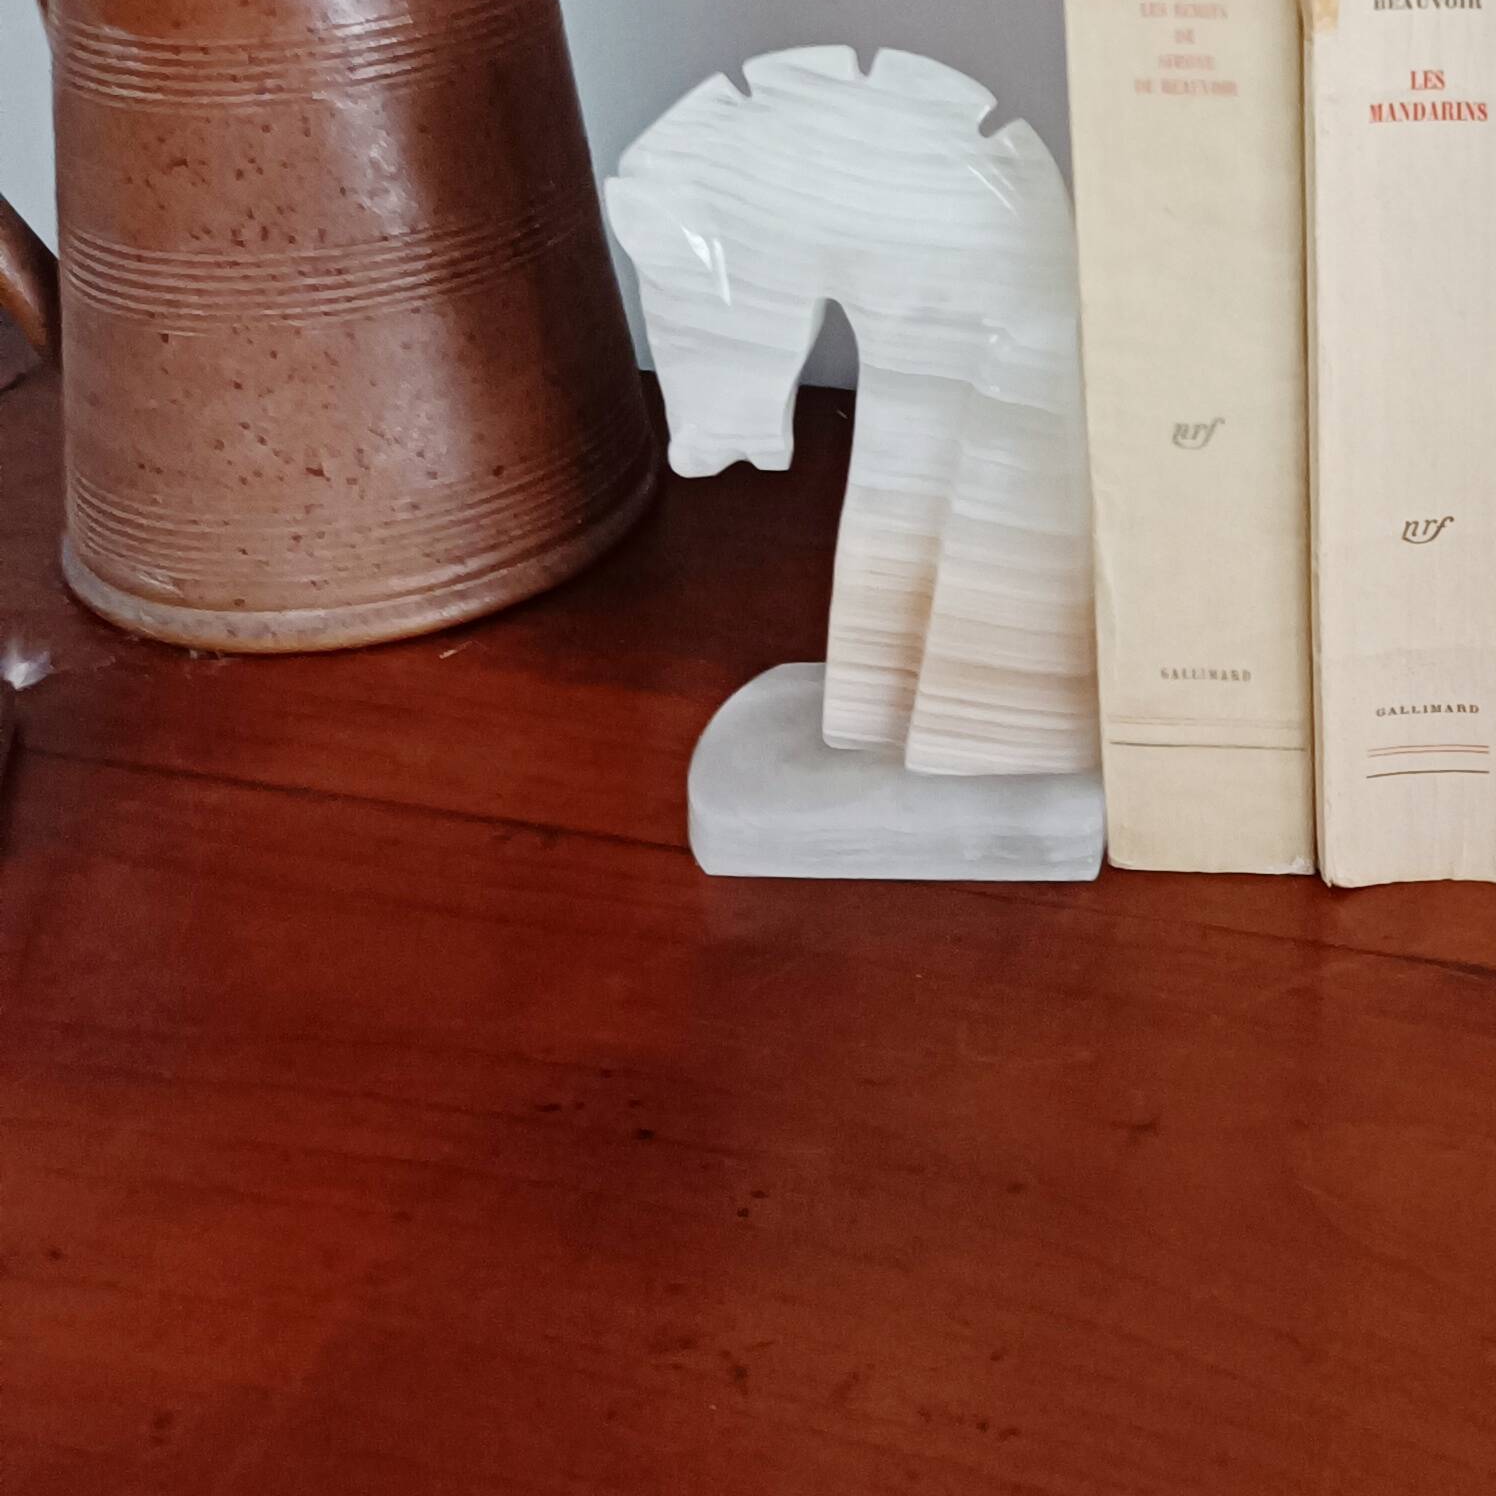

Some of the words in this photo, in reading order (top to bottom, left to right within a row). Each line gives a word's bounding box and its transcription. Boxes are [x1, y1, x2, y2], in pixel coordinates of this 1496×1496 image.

[1410, 70, 1446, 91] LES
[1370, 101, 1489, 124] MANDARINS
[1401, 515, 1455, 545] nrf
[1160, 667, 1251, 682] GALLIMARD
[1376, 703, 1480, 717] GALLIMARD
